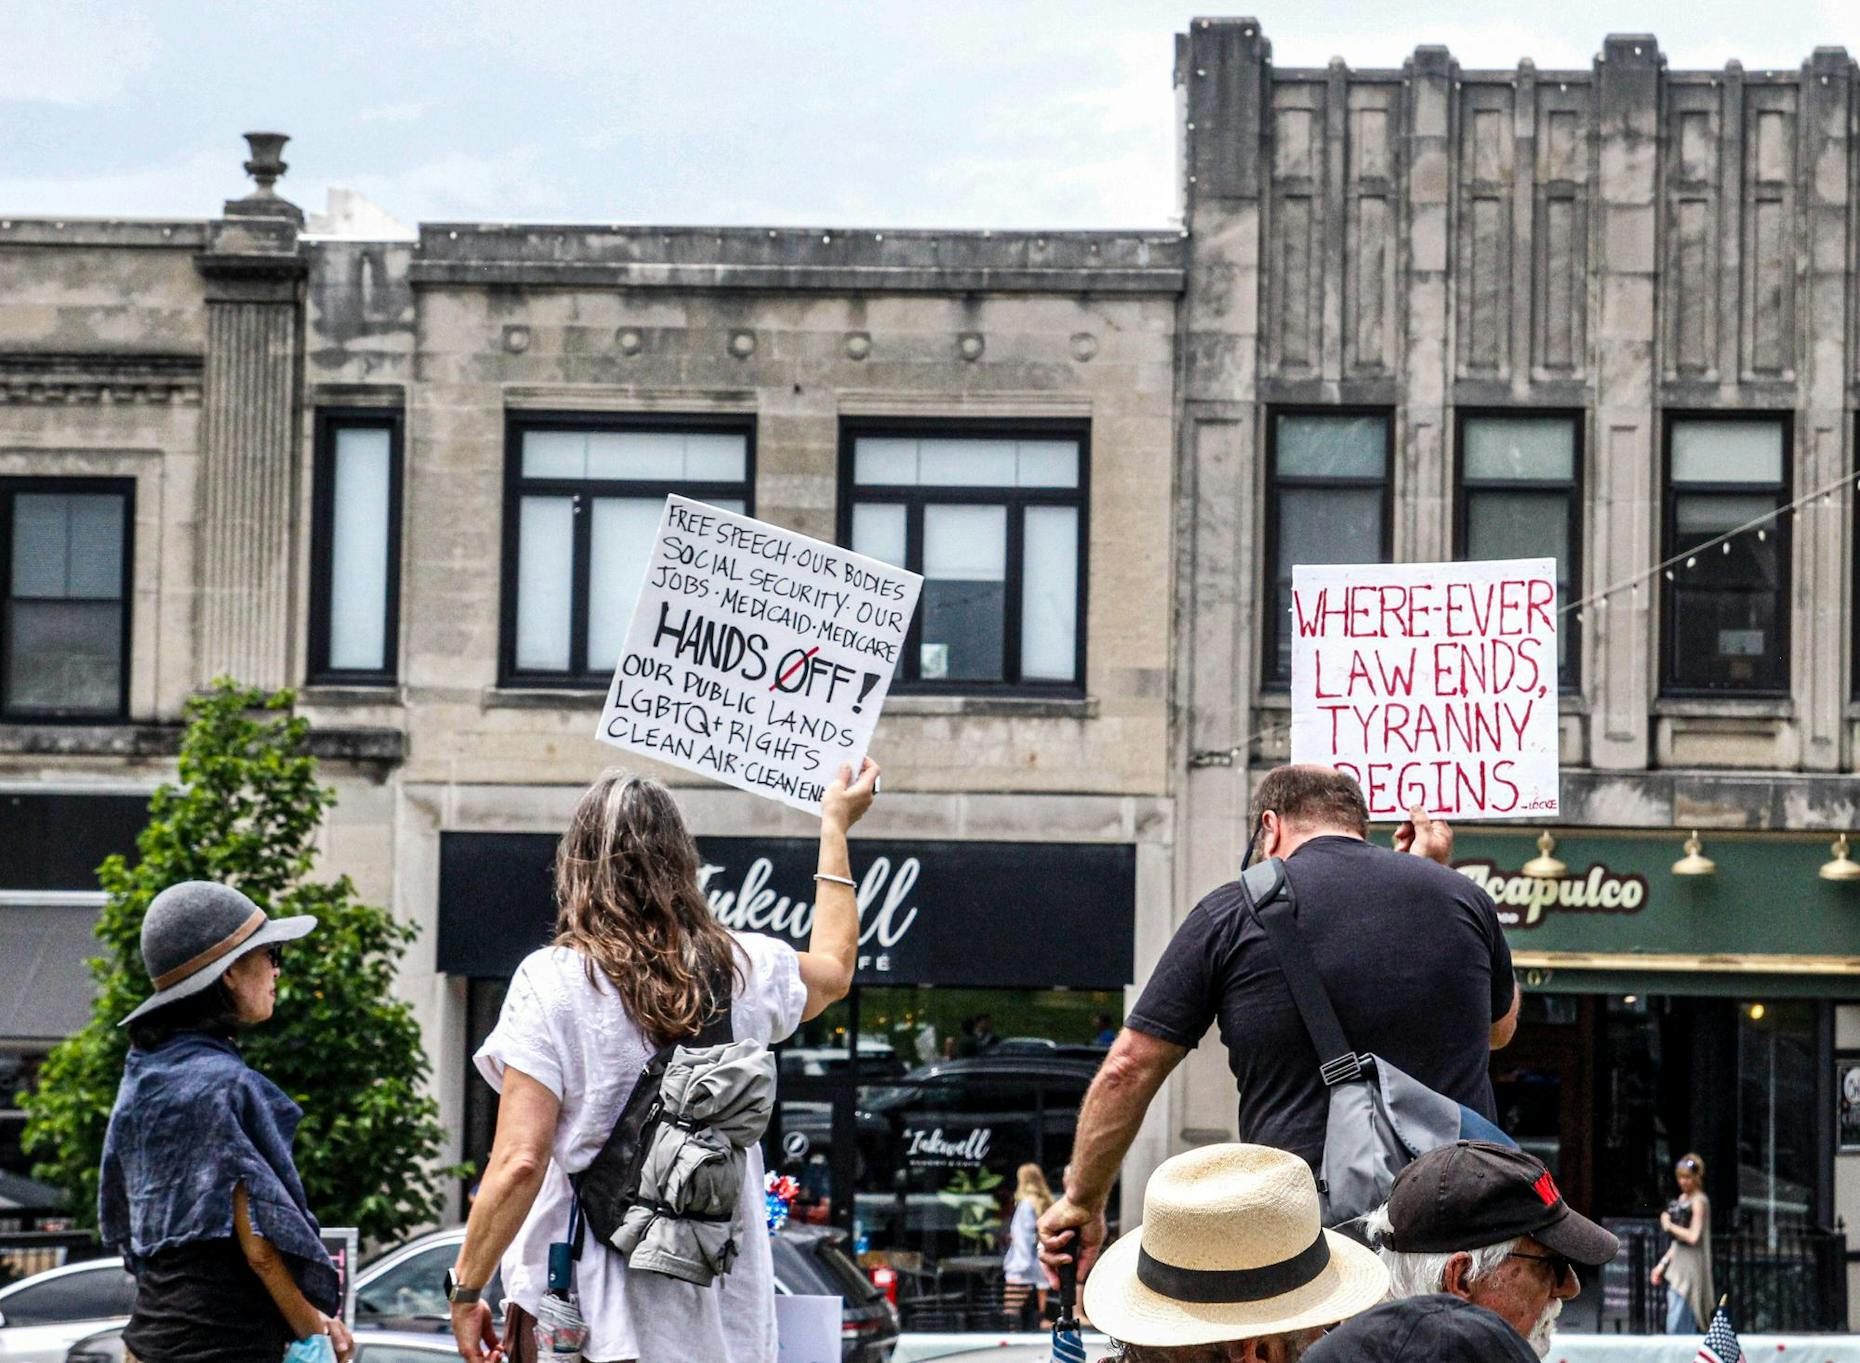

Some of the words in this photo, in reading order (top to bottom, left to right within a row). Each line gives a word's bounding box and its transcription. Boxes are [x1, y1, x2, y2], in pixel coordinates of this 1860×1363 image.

[663, 537, 743, 581] SOCIAL
[857, 602, 902, 632] OUR
[669, 505, 715, 536] FREE
[797, 549, 837, 576] OUR
[845, 563, 905, 600] BODIES
[652, 566, 709, 598] JOBS
[817, 621, 898, 663] MEDICARE
[654, 601, 768, 680] HANDS
[623, 654, 673, 685] OUR
[684, 672, 756, 714] PUBLIC
[768, 700, 854, 747] LANDS
[1316, 648, 1417, 698] LAW
[1434, 638, 1547, 698] ENDS,
[608, 717, 694, 760] CLEAN
[745, 762, 798, 799] CLEAN
[615, 680, 722, 737] LGBTQ+
[728, 720, 820, 771] RIGHTS
[1317, 700, 1533, 755] TYRANNY
[858, 952, 891, 971] FÉ
